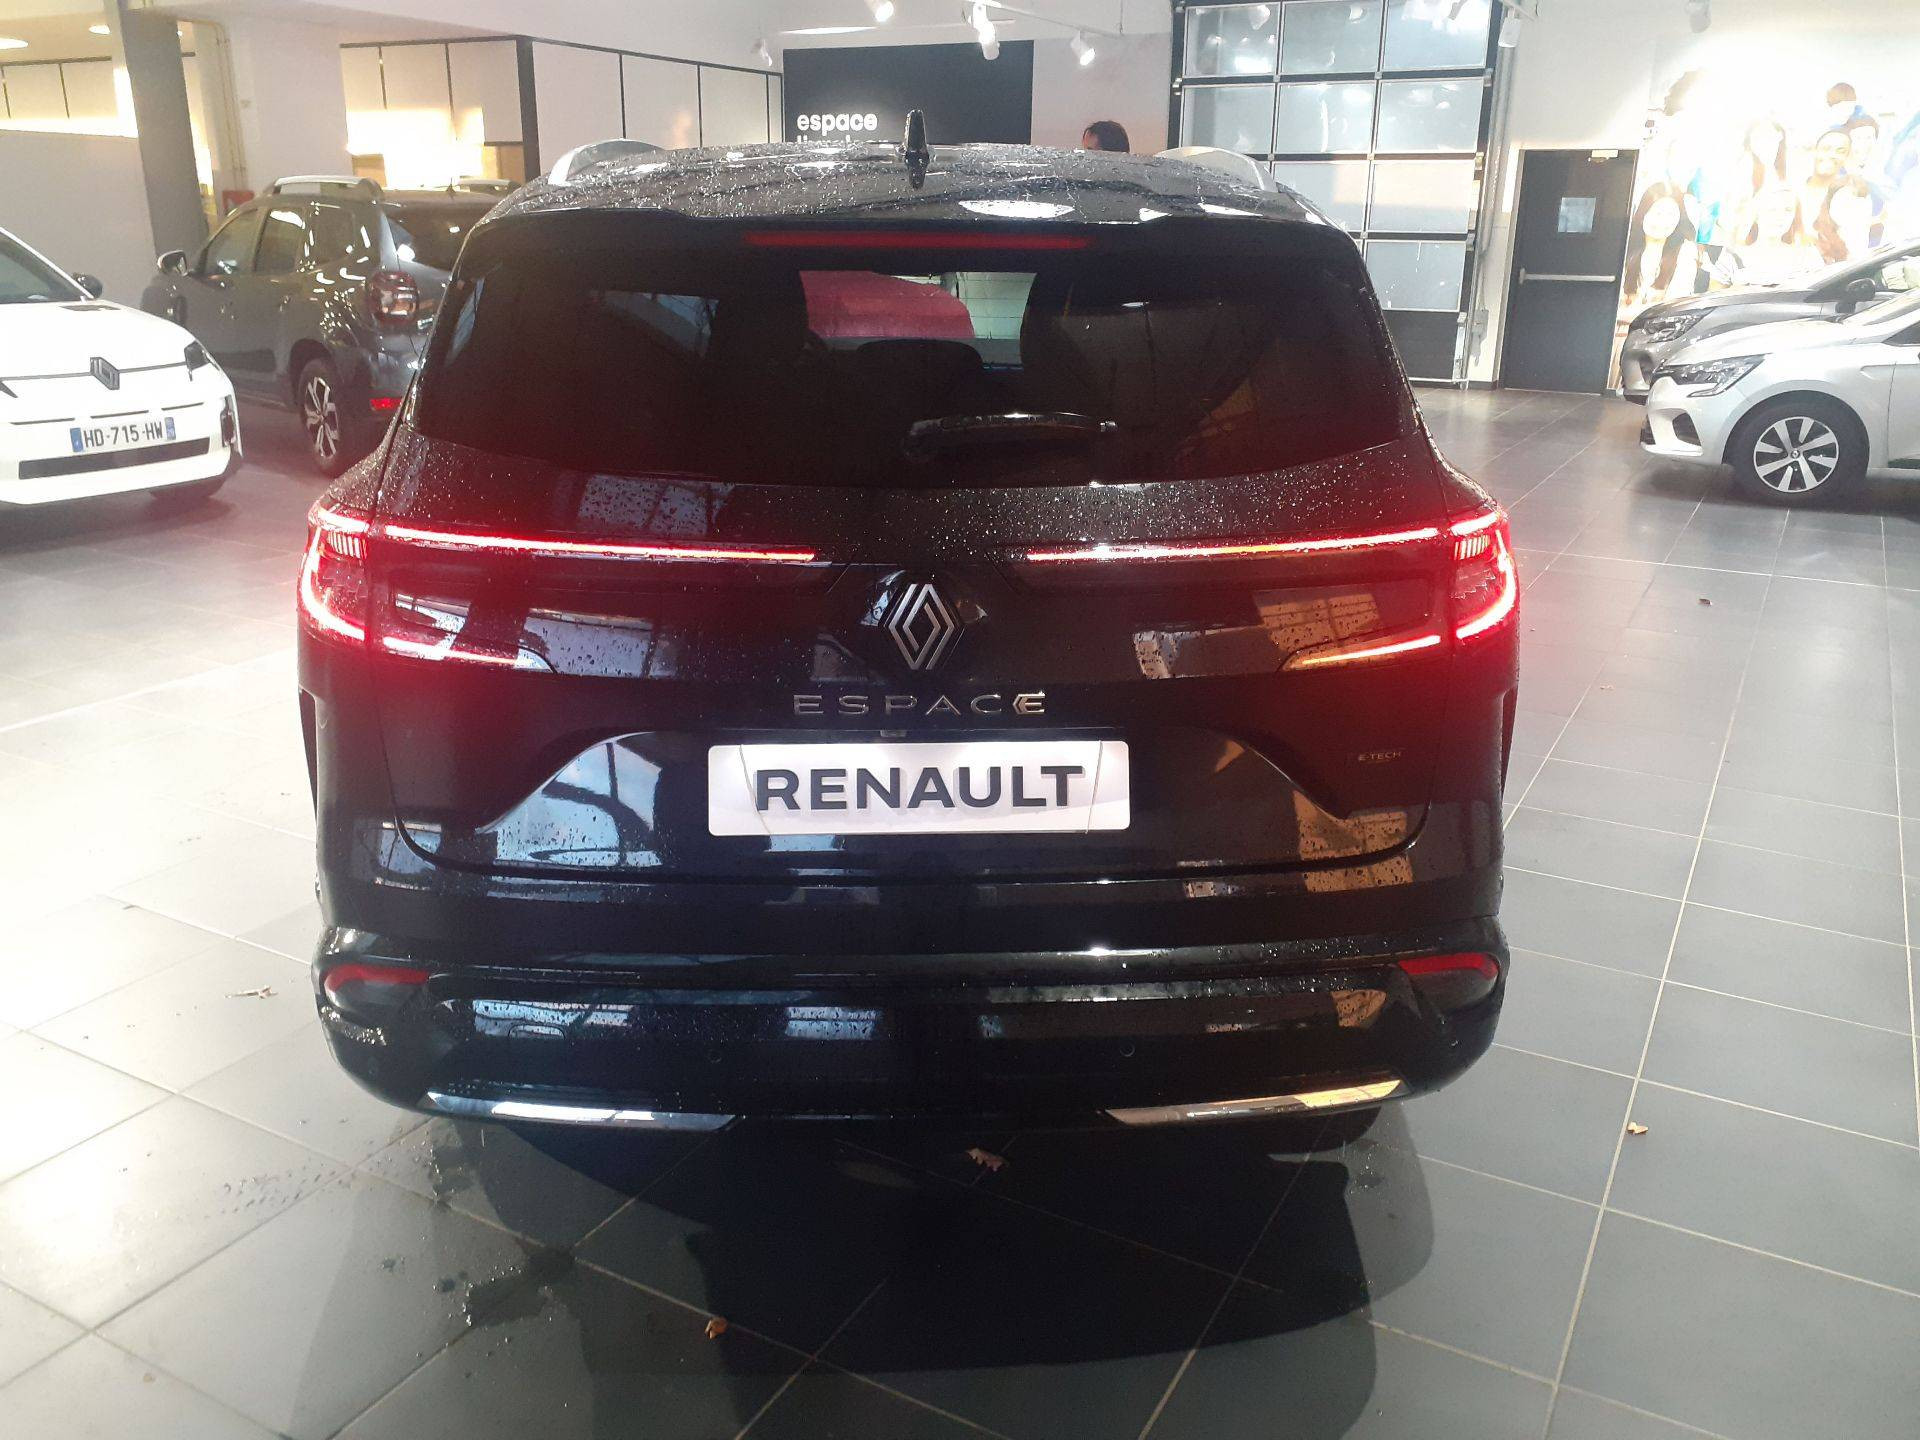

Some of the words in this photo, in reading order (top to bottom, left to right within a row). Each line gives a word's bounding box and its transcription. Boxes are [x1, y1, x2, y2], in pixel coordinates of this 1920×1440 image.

[797, 113, 878, 136] espace
[83, 421, 163, 447] HD-715-HW
[793, 692, 1046, 716] ESPACE
[755, 764, 1084, 812] RENAULT
